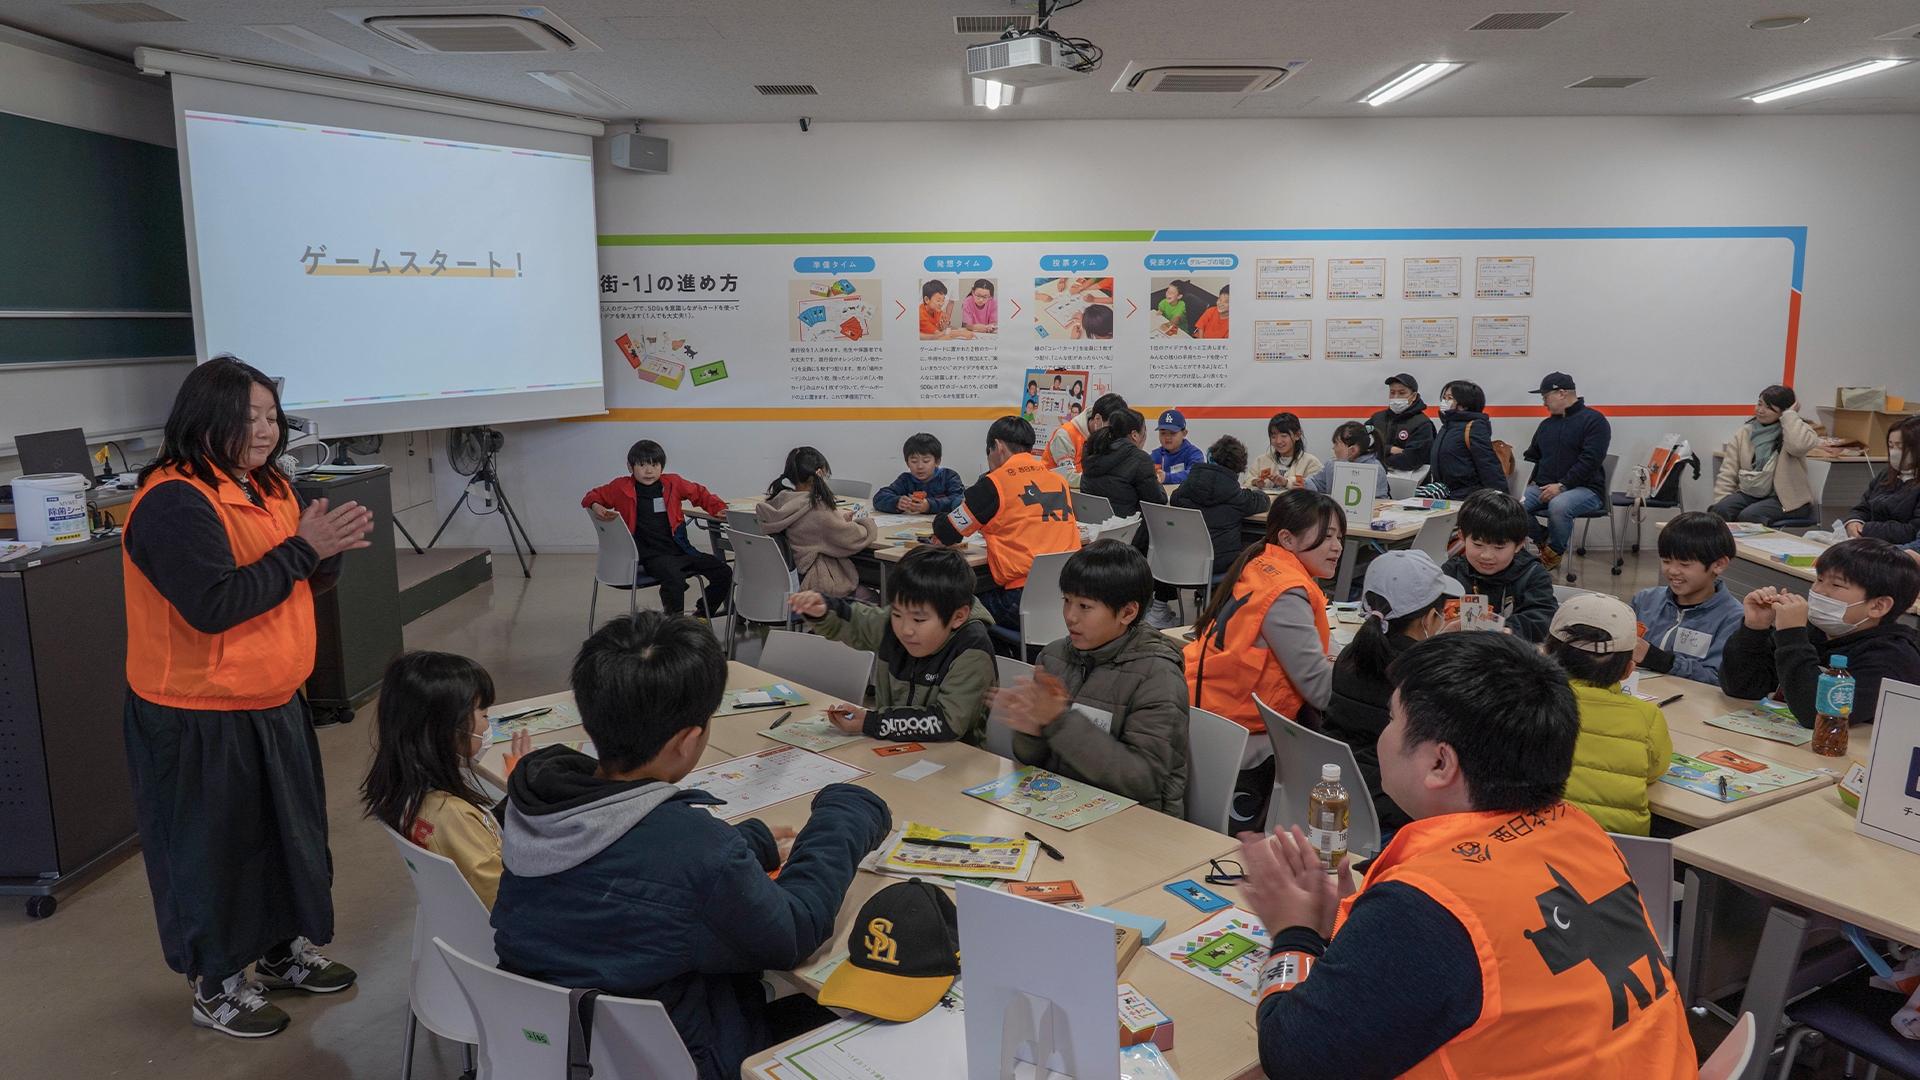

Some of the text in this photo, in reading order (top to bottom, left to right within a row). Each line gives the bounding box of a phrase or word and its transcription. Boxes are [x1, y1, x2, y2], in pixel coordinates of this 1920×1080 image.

[300, 244, 523, 278] ゲームスタート!
[812, 261, 857, 269] 準備タイム
[936, 259, 981, 268] 発想タイム
[1052, 259, 1096, 267] 投票タイム
[1149, 258, 1232, 267] 発表タイム グループの場合
[1344, 485, 1362, 507] D
[281, 964, 311, 985] N
[212, 1002, 240, 1026] N
